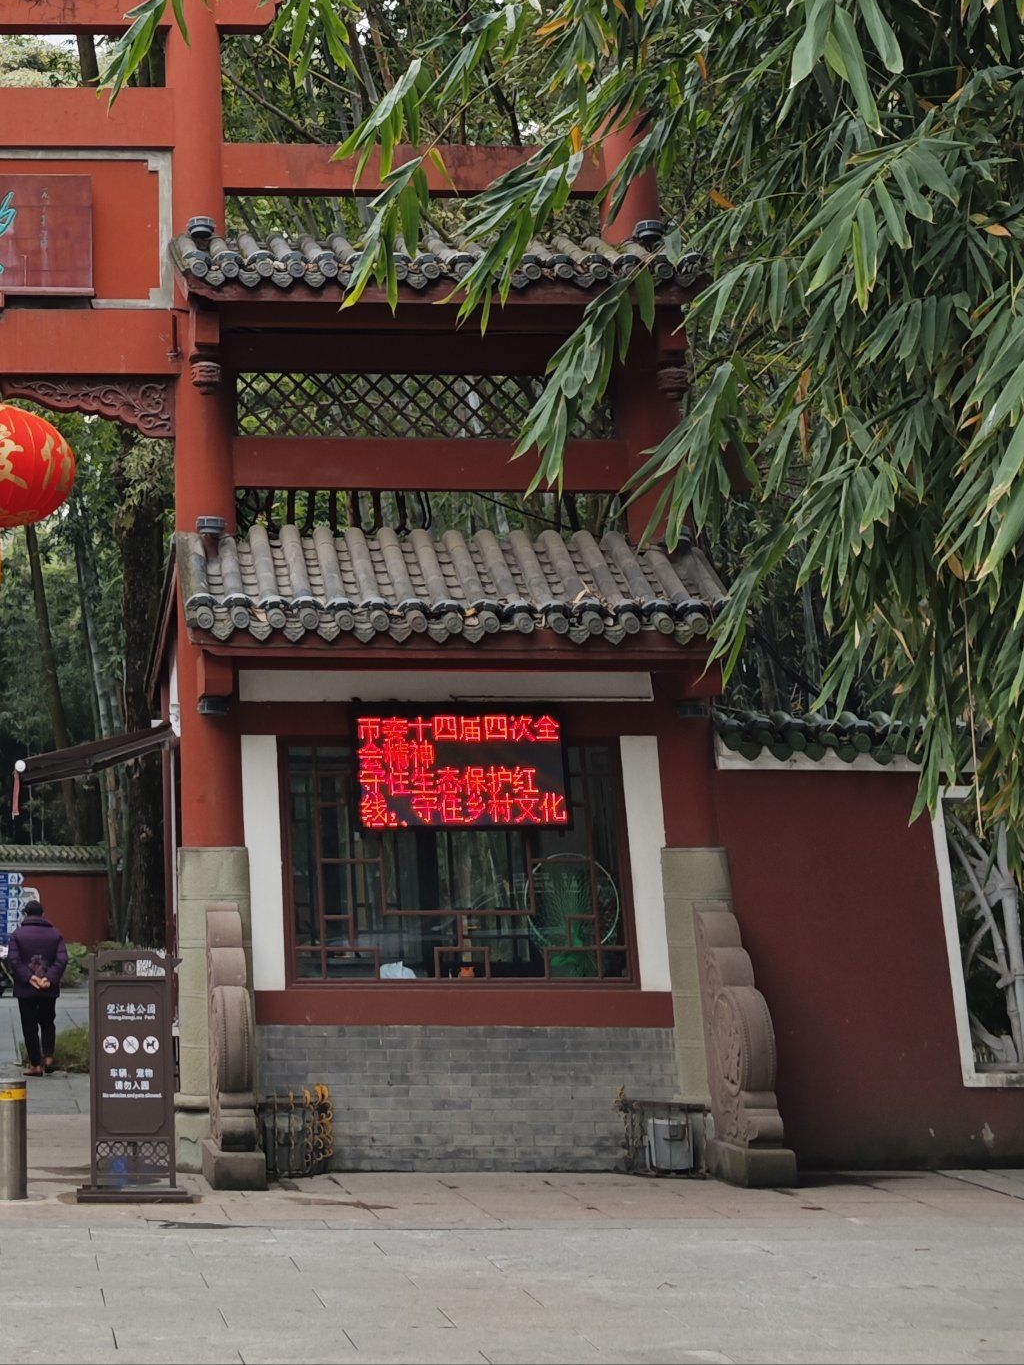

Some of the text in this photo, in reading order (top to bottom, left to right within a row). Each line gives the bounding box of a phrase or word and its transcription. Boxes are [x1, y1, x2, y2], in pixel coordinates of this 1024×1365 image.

[359, 766, 539, 796] 守住生态保护红
[107, 1003, 155, 1014] 望江楼公园
[115, 1081, 150, 1090] 请勿入园
